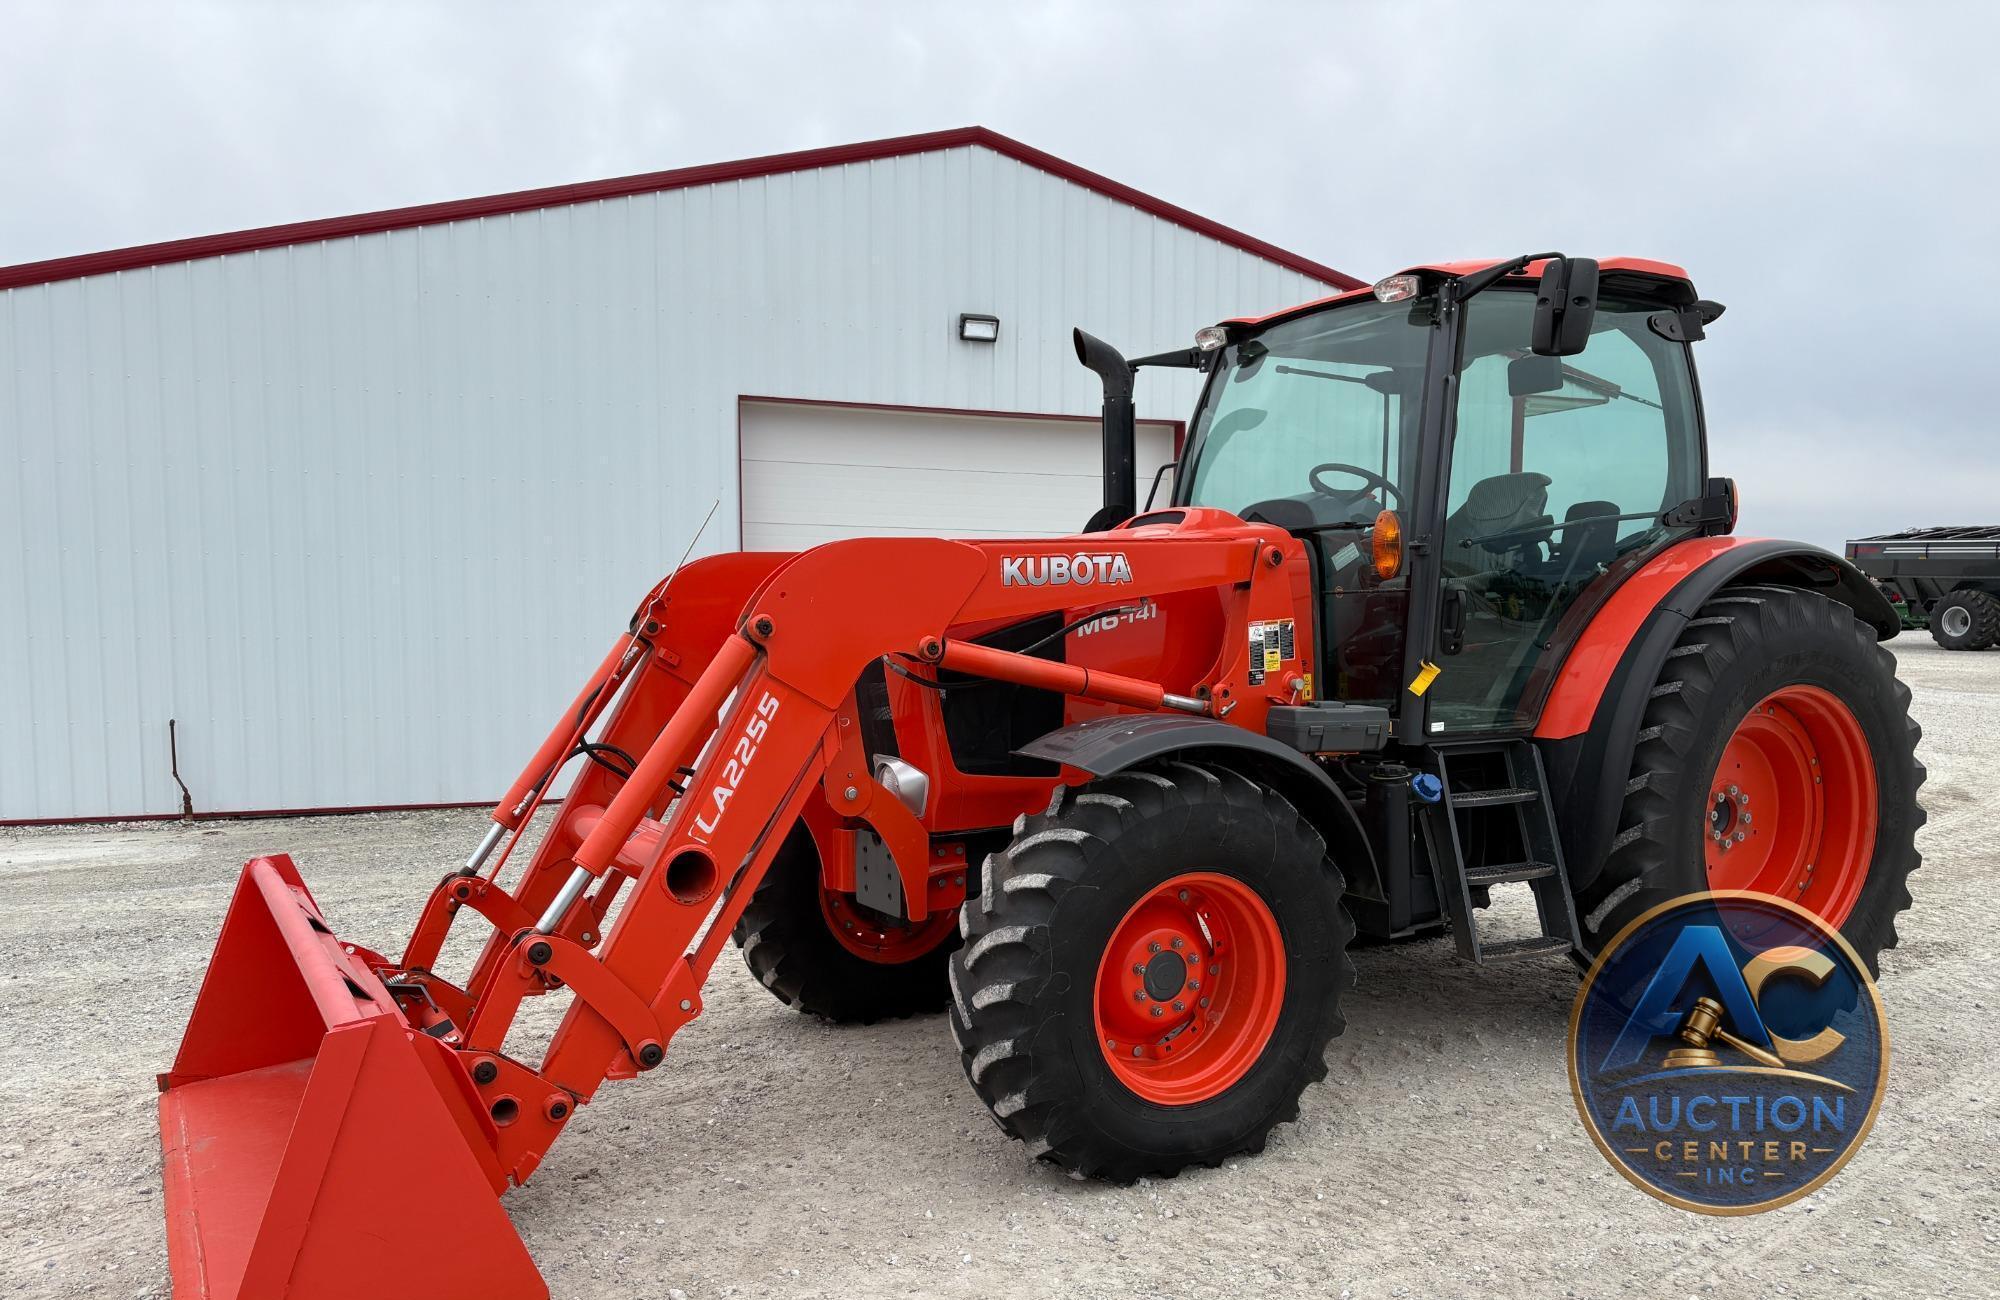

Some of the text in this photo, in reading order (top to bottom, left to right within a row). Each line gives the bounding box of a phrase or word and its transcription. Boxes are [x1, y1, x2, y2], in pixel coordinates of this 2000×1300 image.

[1001, 552, 1132, 586] KUBOTA
[1077, 603, 1157, 637] M6-141
[695, 691, 780, 835] LA2255
